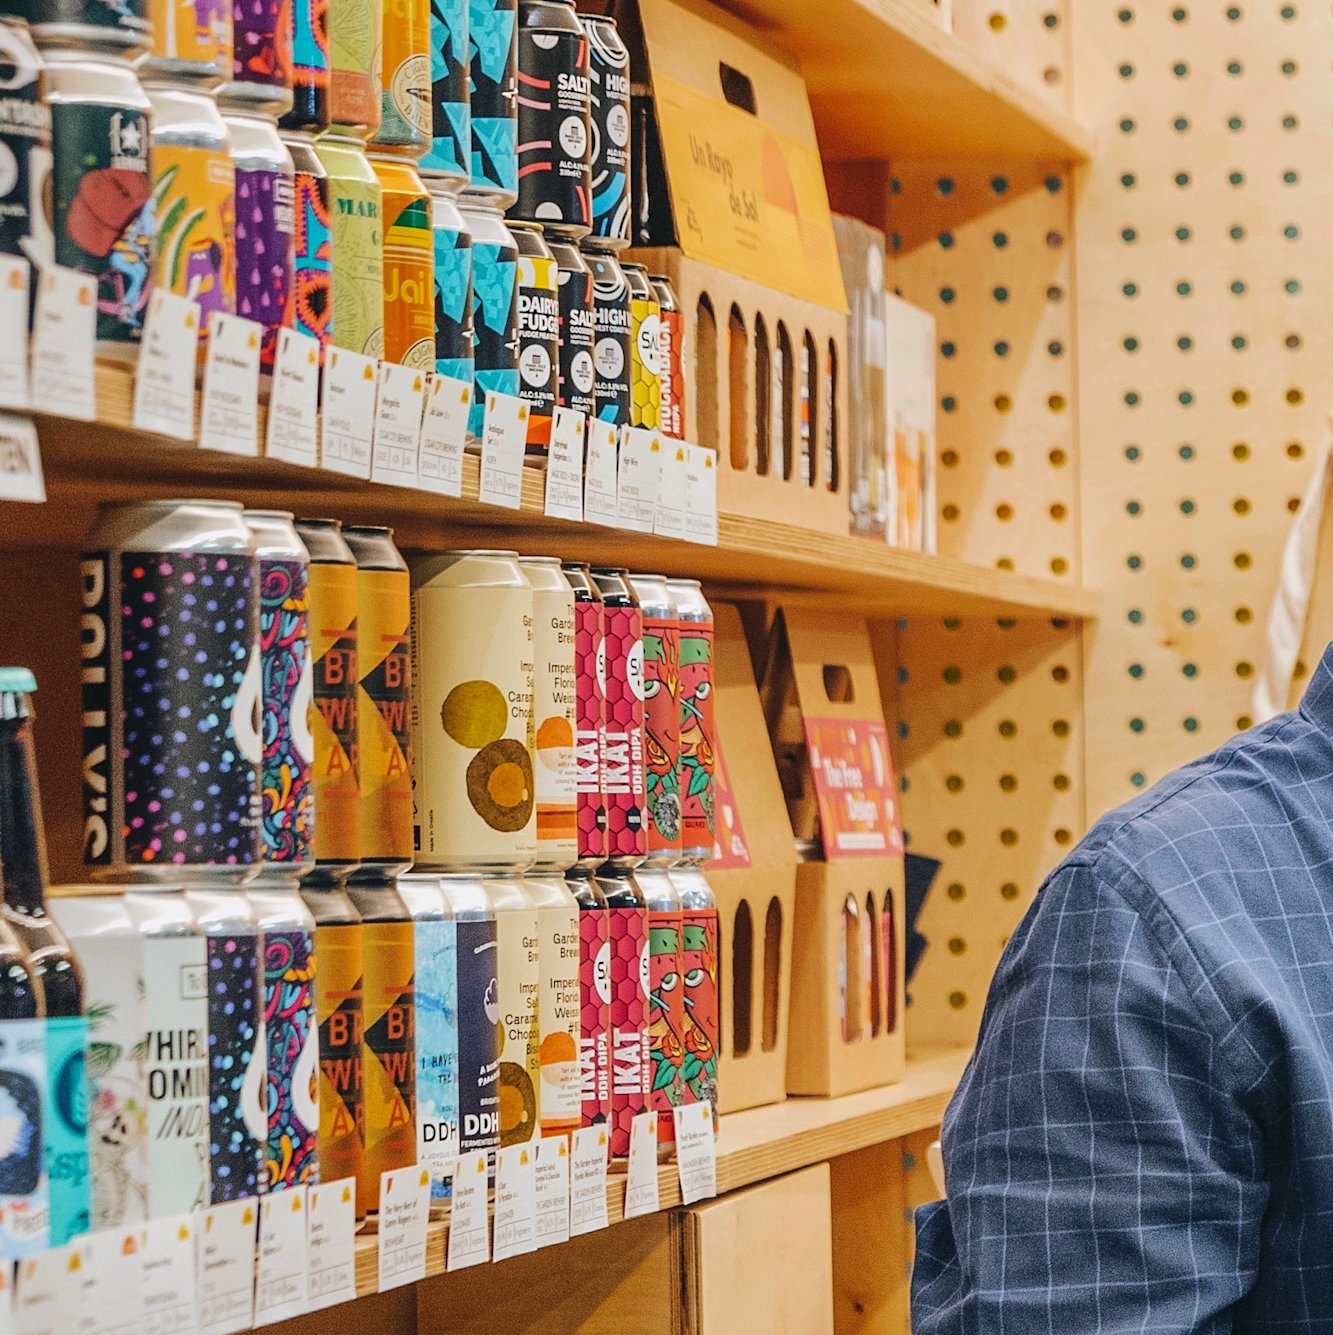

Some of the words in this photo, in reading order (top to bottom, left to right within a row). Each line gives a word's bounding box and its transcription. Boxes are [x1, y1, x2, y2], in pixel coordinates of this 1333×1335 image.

[606, 731, 631, 794] IKAT
[613, 1027, 641, 1095] IKAT
[423, 1121, 457, 1143] DDH
[464, 1111, 499, 1137] DDH
